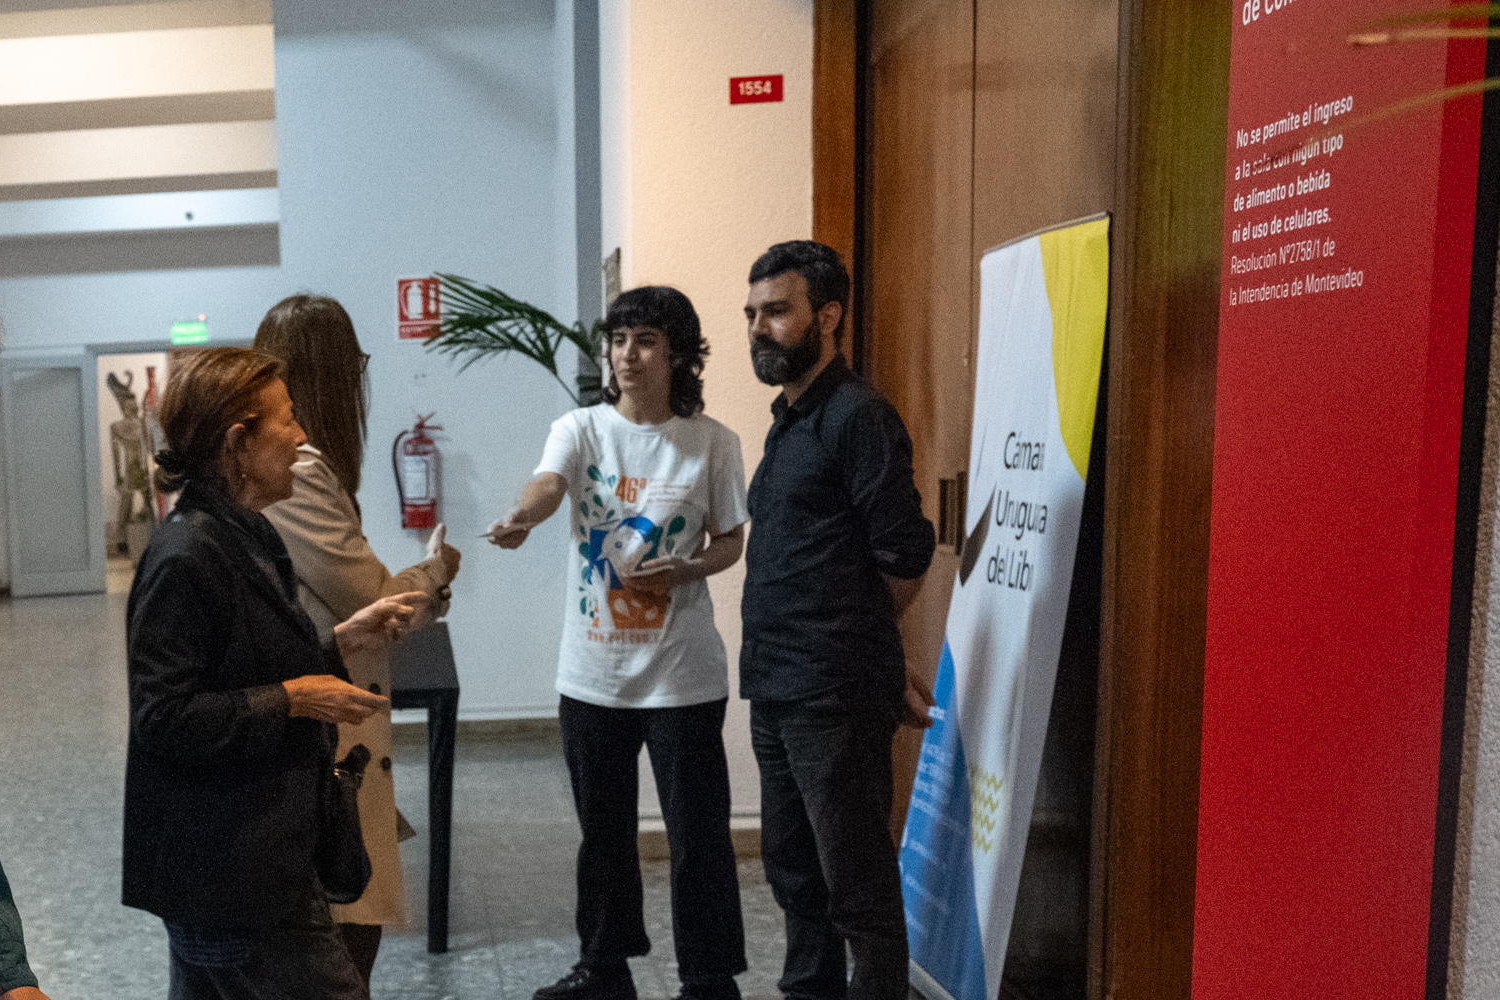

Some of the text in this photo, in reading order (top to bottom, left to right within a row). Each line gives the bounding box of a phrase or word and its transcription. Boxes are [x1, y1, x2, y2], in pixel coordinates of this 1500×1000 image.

[738, 80, 772, 96] 1554
[1236, 95, 1353, 149] No se permite el ingreso
[1235, 165, 1241, 180] a
[1242, 160, 1250, 178] la
[1252, 153, 1271, 175] sala
[1322, 132, 1343, 157] tipo
[1234, 168, 1331, 213] de alimento o bebida
[1232, 207, 1331, 244] ni el uso de celulares.
[1231, 247, 1277, 275] Resolución
[1323, 236, 1336, 257] de
[1229, 267, 1363, 306] la Intendencia de Montevideo
